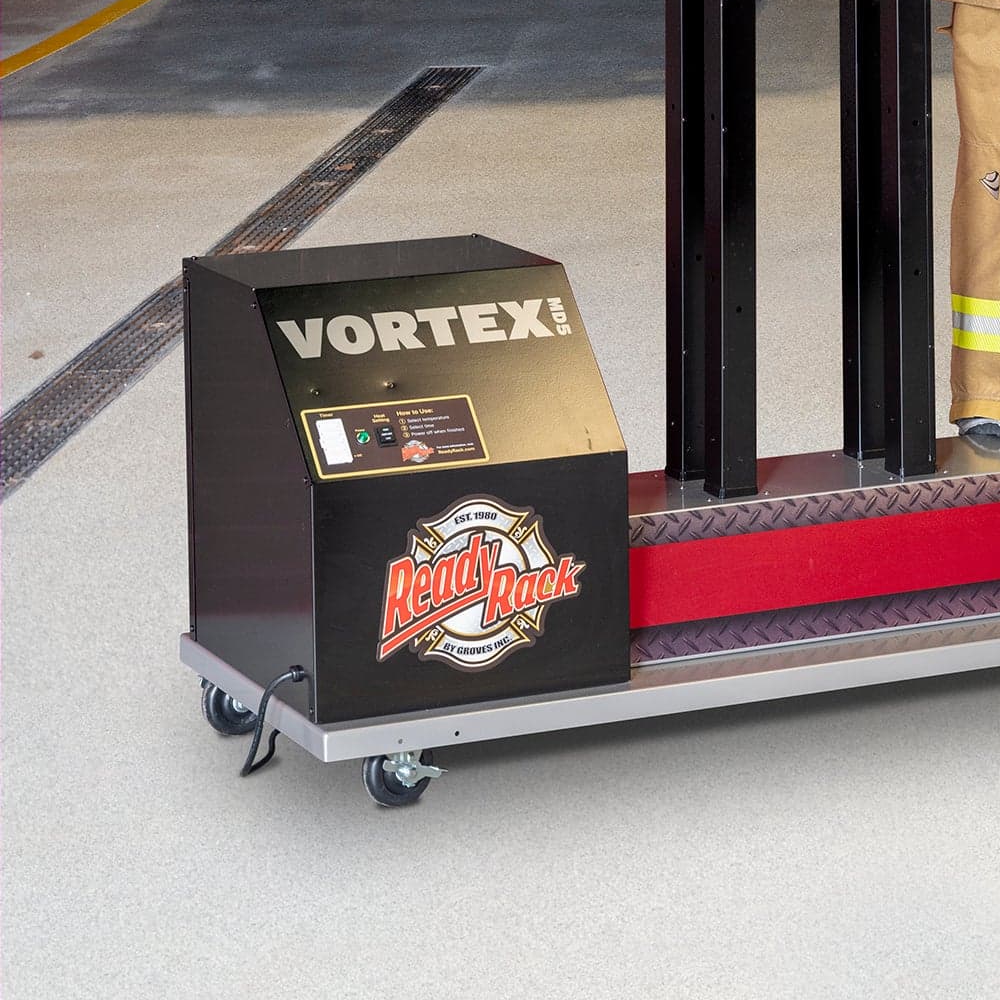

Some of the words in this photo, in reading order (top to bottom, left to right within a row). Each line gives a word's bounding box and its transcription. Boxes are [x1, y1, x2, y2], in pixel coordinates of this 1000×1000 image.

[276, 298, 555, 359] VORTEX
[547, 297, 573, 336] MD5
[454, 511, 473, 525] EST.
[475, 511, 498, 520] 1980
[382, 532, 500, 640] Ready
[482, 556, 587, 628] Rack
[443, 642, 456, 651] BY
[457, 644, 493, 655] GROVES
[494, 636, 513, 650] INC.
